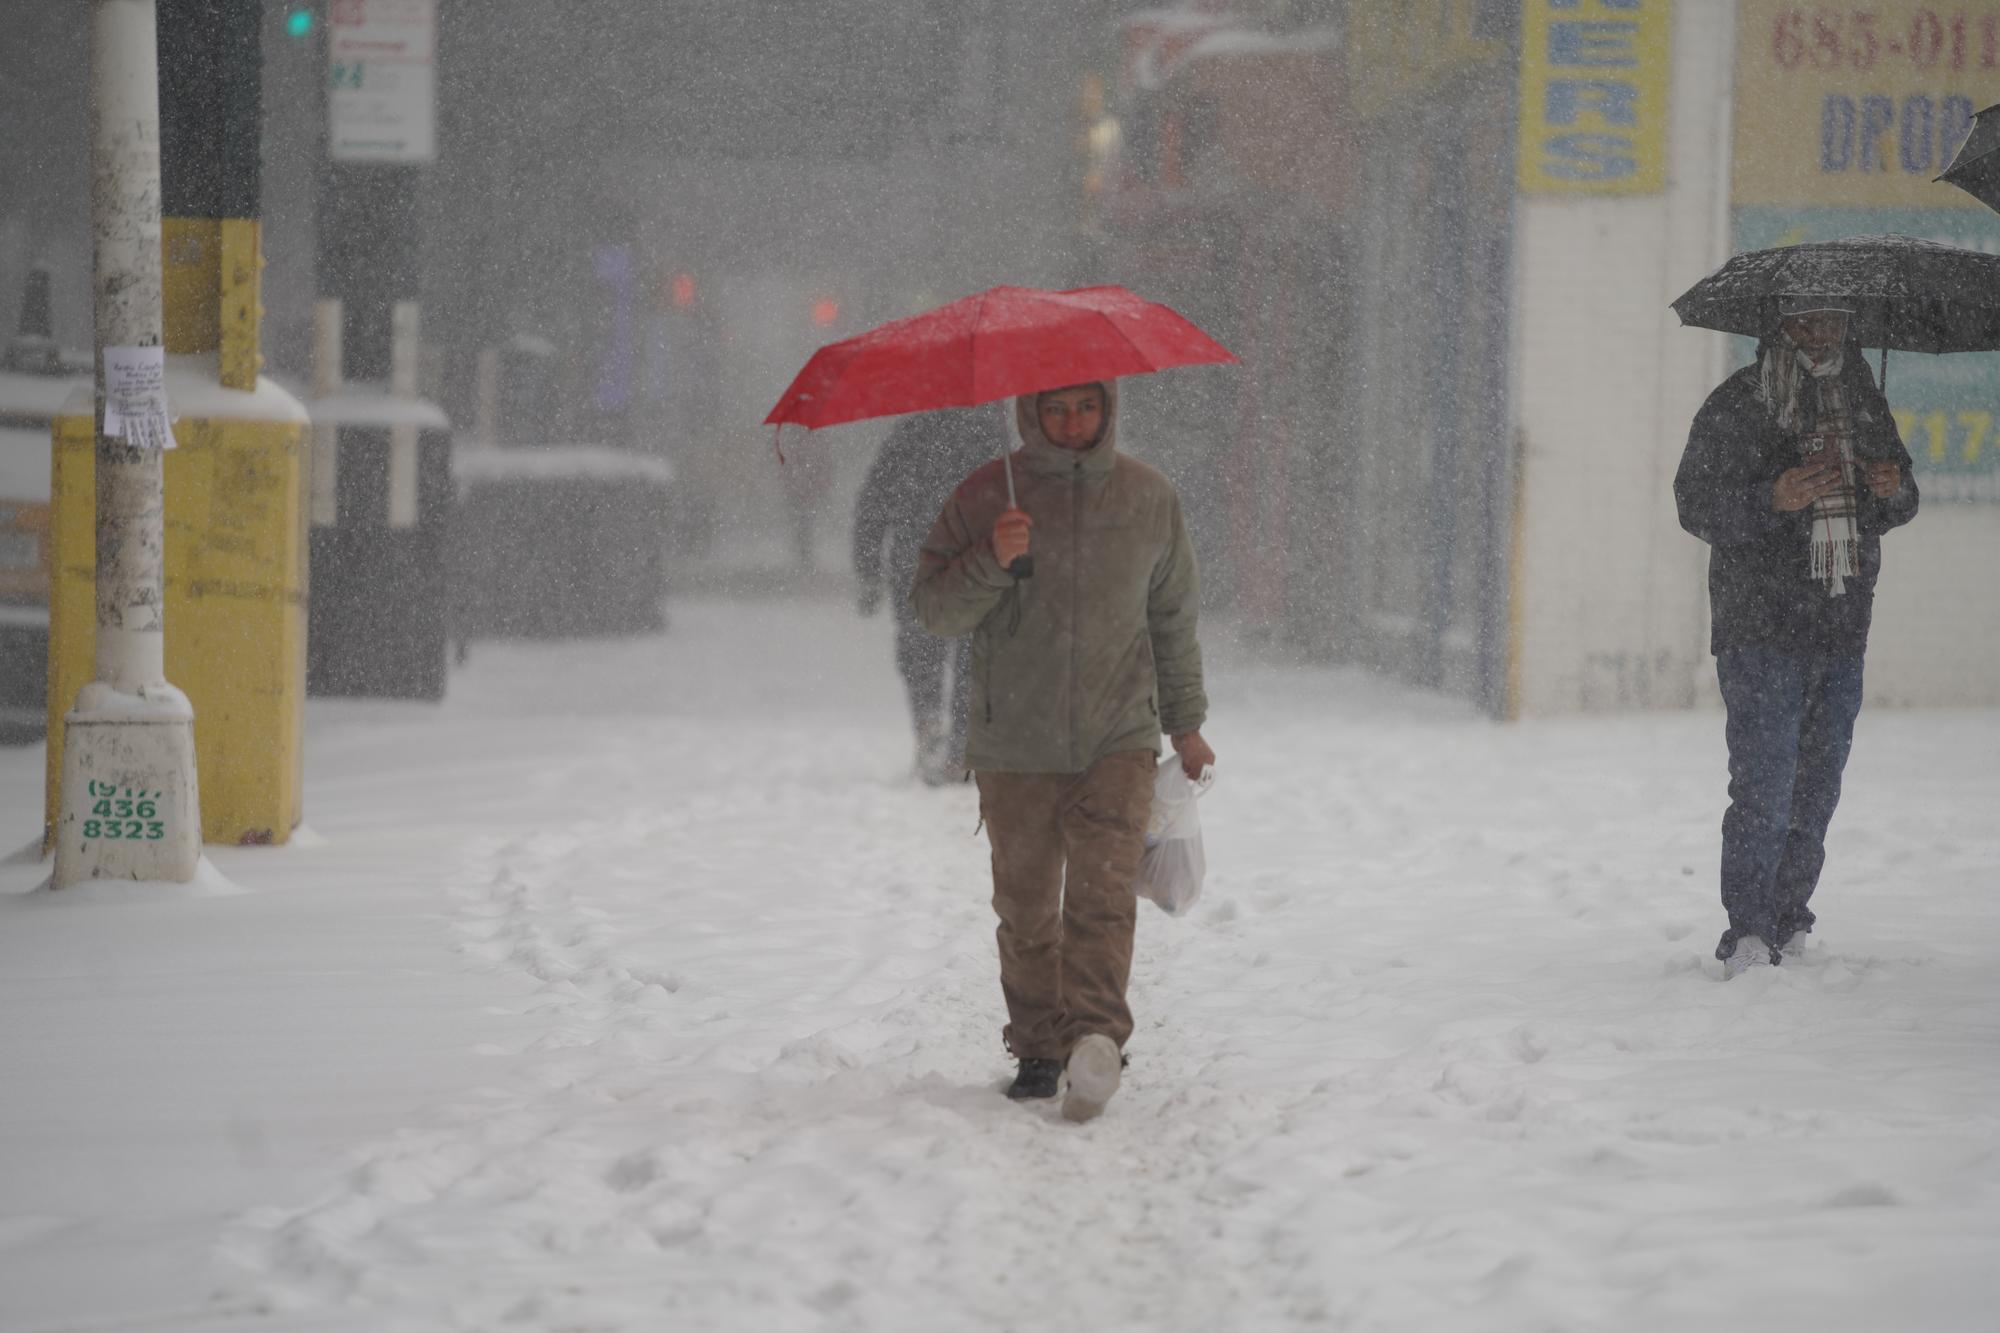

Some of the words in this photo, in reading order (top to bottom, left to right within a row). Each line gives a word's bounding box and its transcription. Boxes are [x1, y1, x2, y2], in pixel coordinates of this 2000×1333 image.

[1541, 0, 1640, 181] ERS
[92, 800, 156, 818] 436
[83, 820, 164, 839] 8323
